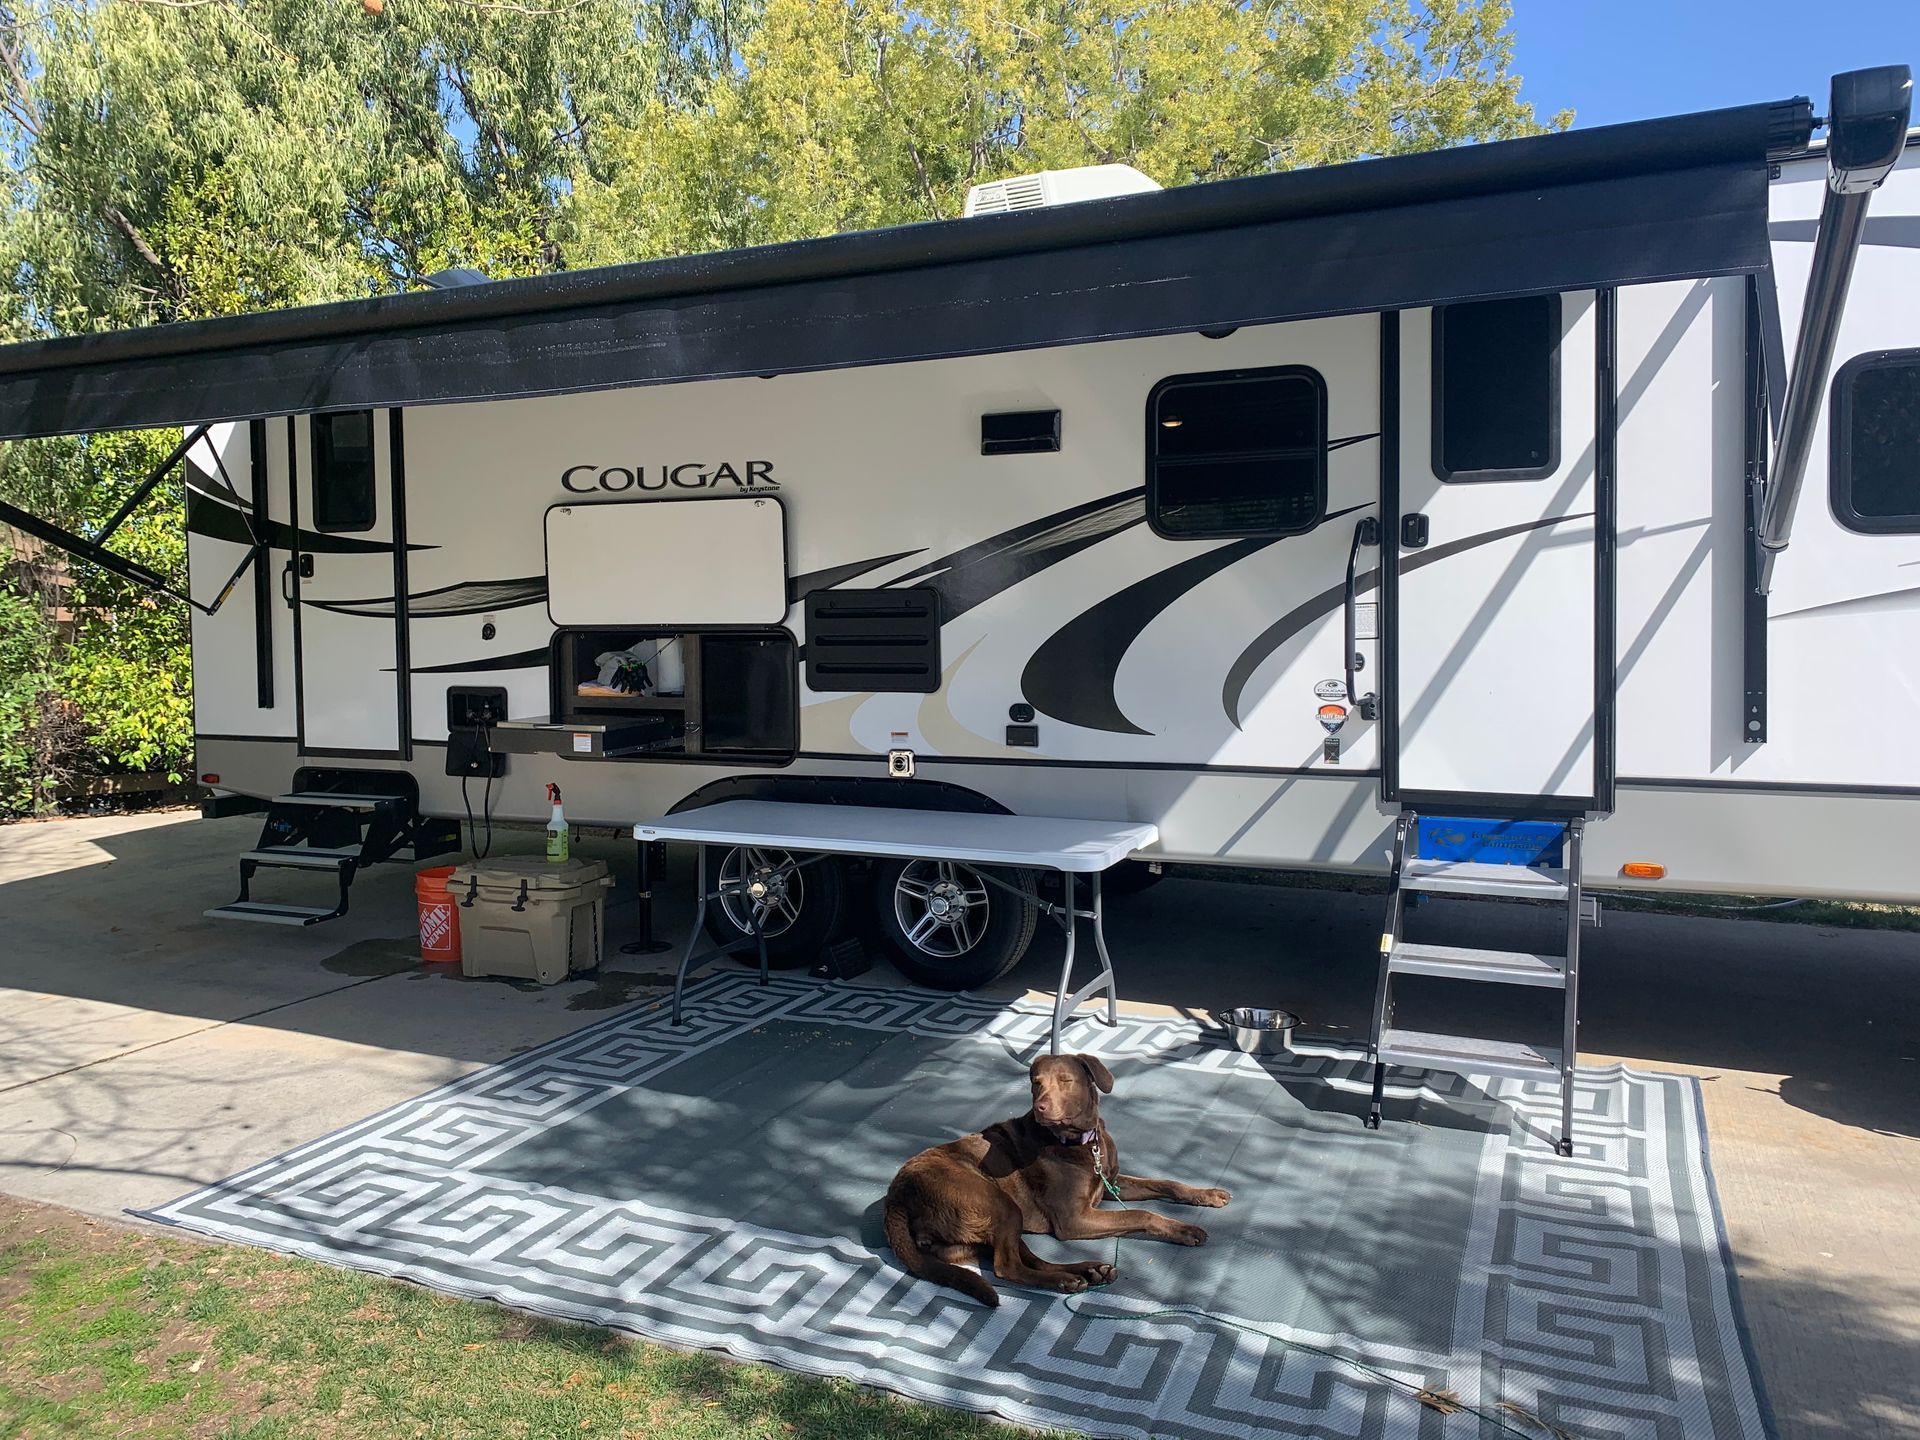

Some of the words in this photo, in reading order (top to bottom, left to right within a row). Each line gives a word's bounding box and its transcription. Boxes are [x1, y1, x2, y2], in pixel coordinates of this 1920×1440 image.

[561, 461, 780, 493] COUGAR
[740, 486, 748, 494] by
[420, 907, 430, 921] THE
[420, 904, 448, 946] HOME
[427, 921, 449, 948] DEPOT
